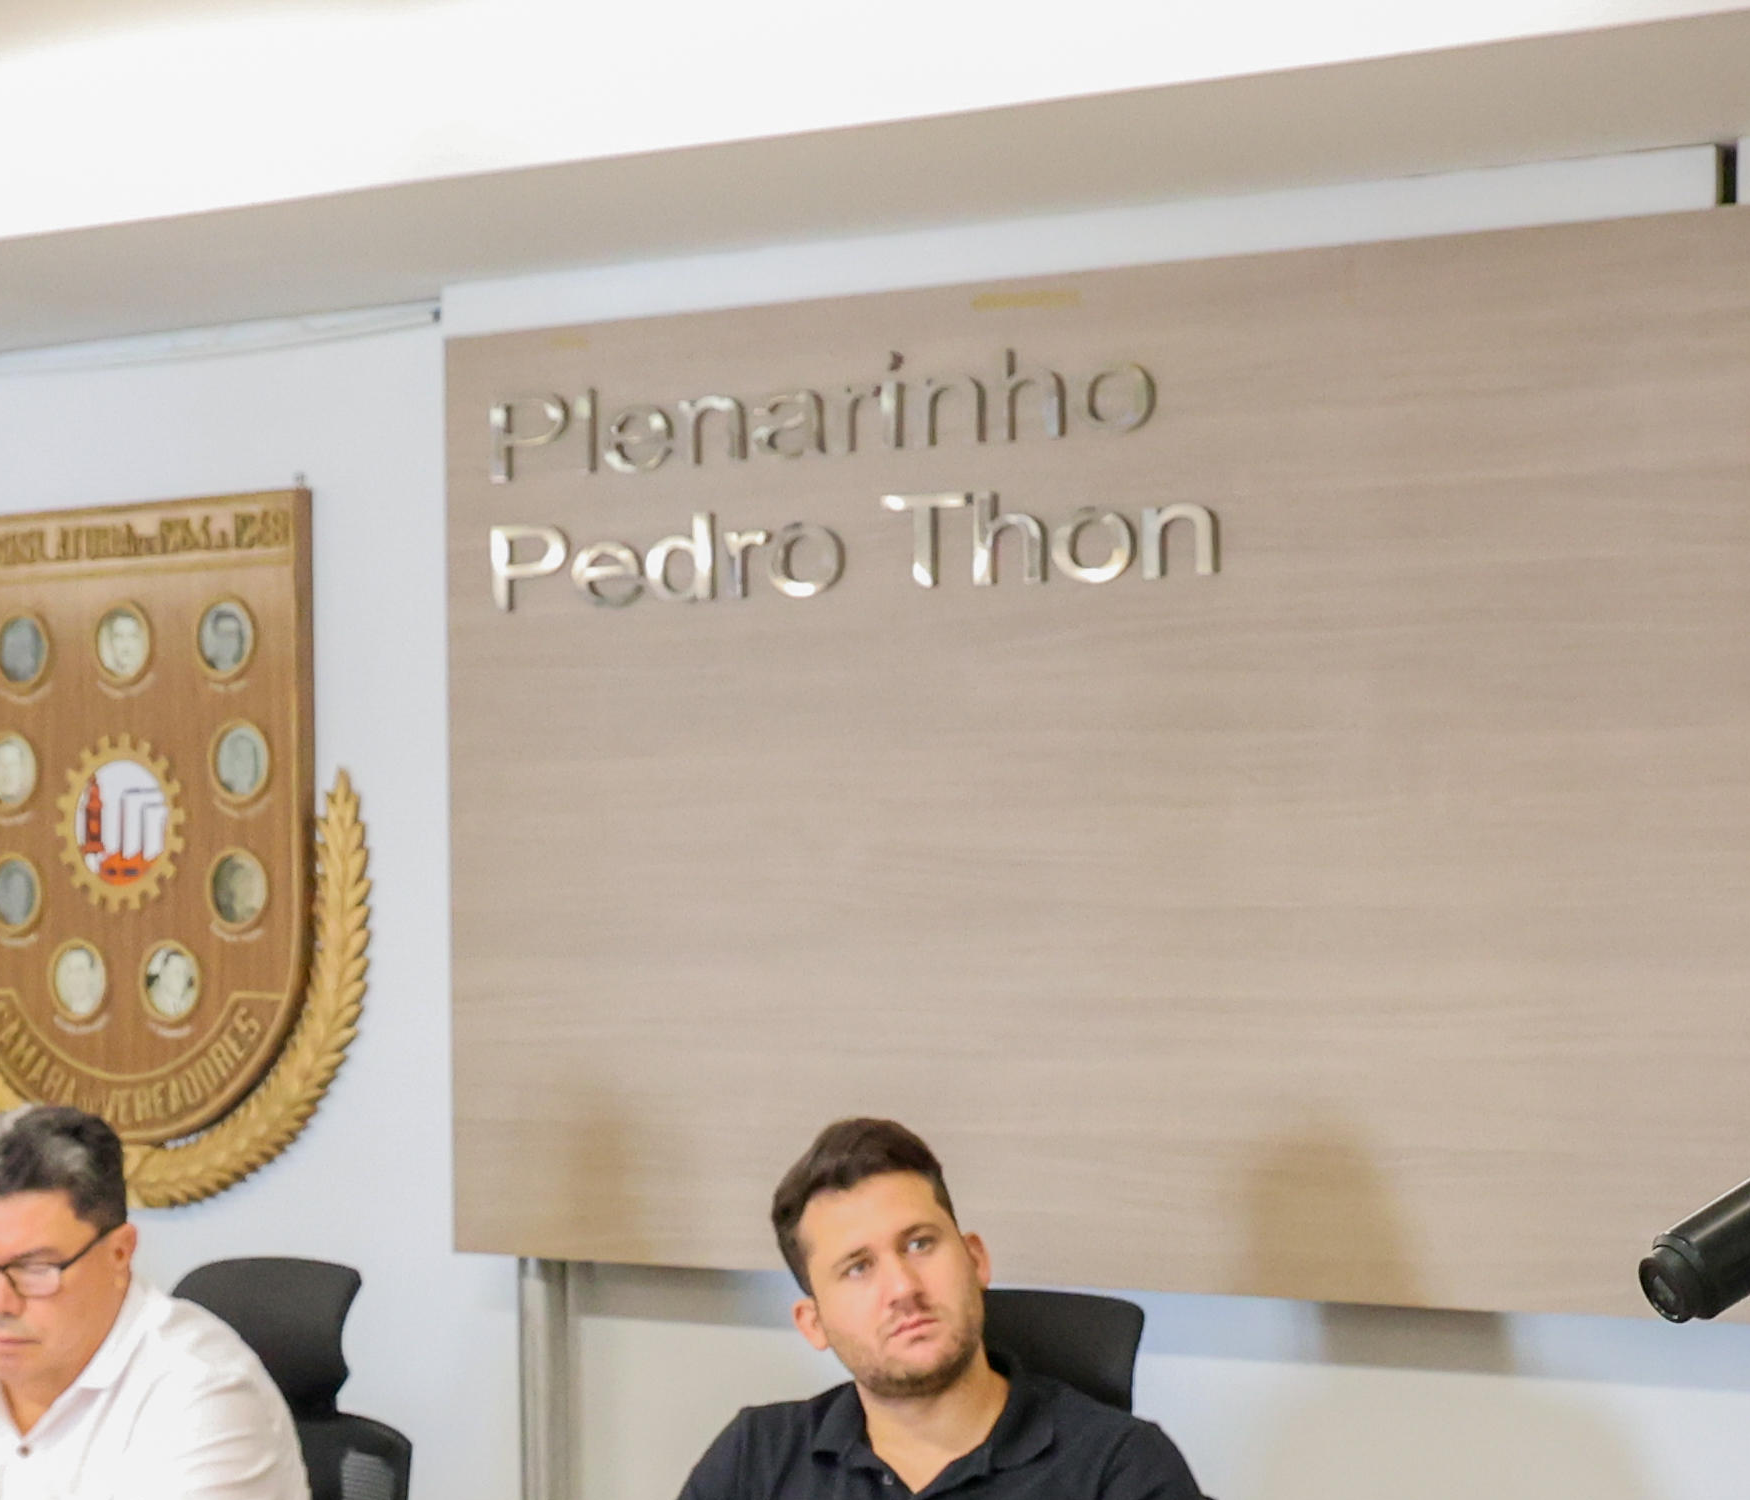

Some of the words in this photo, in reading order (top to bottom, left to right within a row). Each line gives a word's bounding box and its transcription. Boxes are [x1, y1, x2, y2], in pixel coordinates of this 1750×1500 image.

[489, 348, 1156, 484] Plenarinho
[489, 511, 846, 611] Pedro
[880, 490, 1221, 589] Thon
